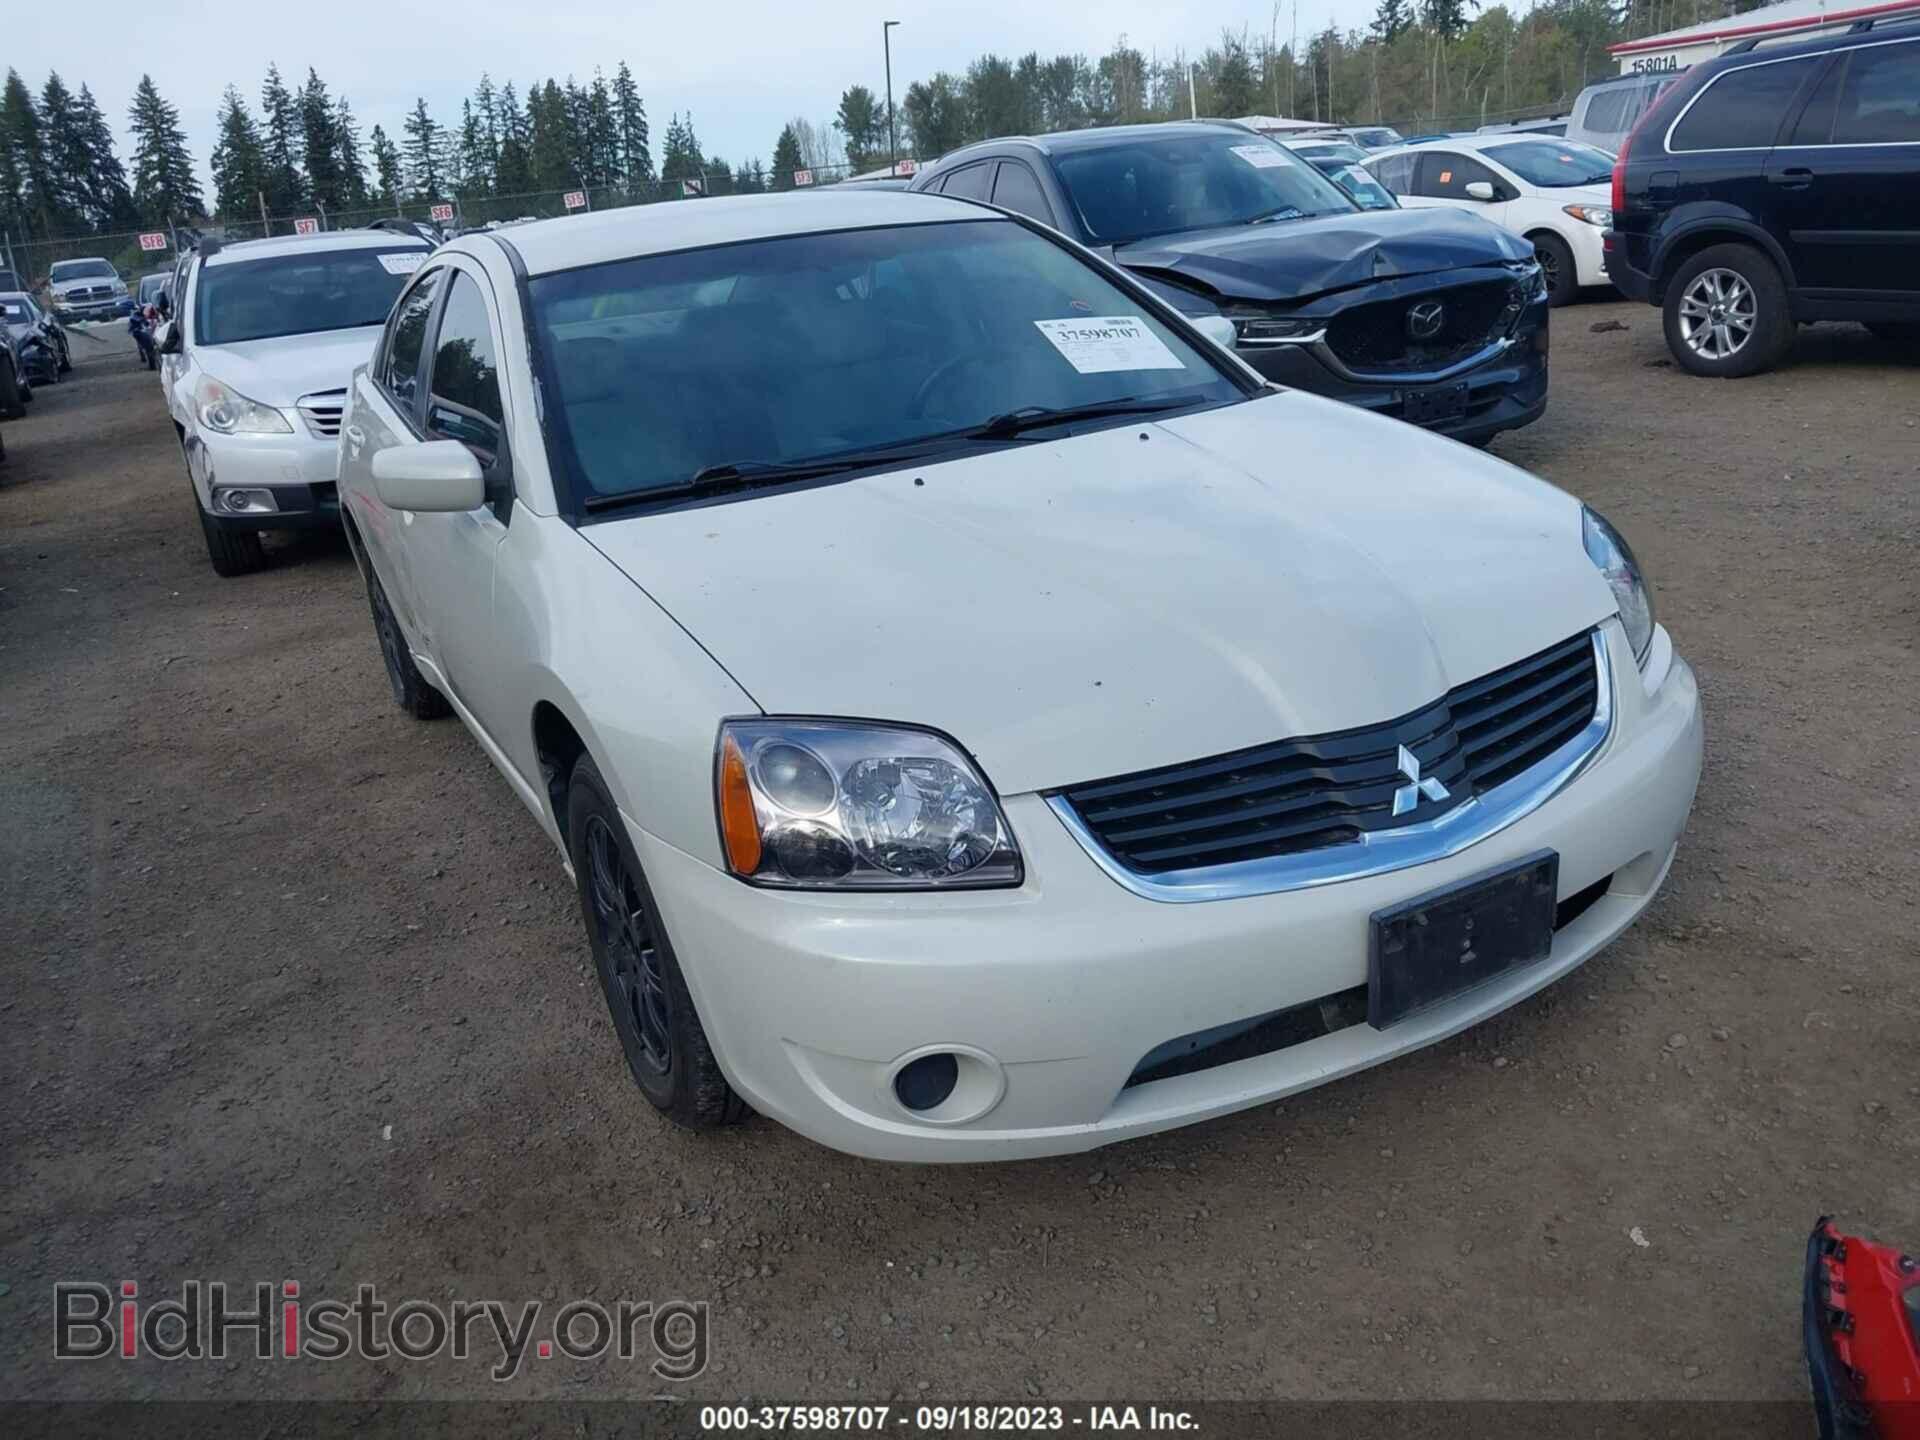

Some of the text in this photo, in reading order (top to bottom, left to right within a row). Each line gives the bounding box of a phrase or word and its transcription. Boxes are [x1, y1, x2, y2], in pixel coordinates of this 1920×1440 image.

[1632, 55, 1677, 73] 15801A
[432, 206, 451, 219] SF6
[296, 220, 318, 234] SF7
[142, 235, 165, 249] SF8
[1056, 327, 1140, 341] 37598707
